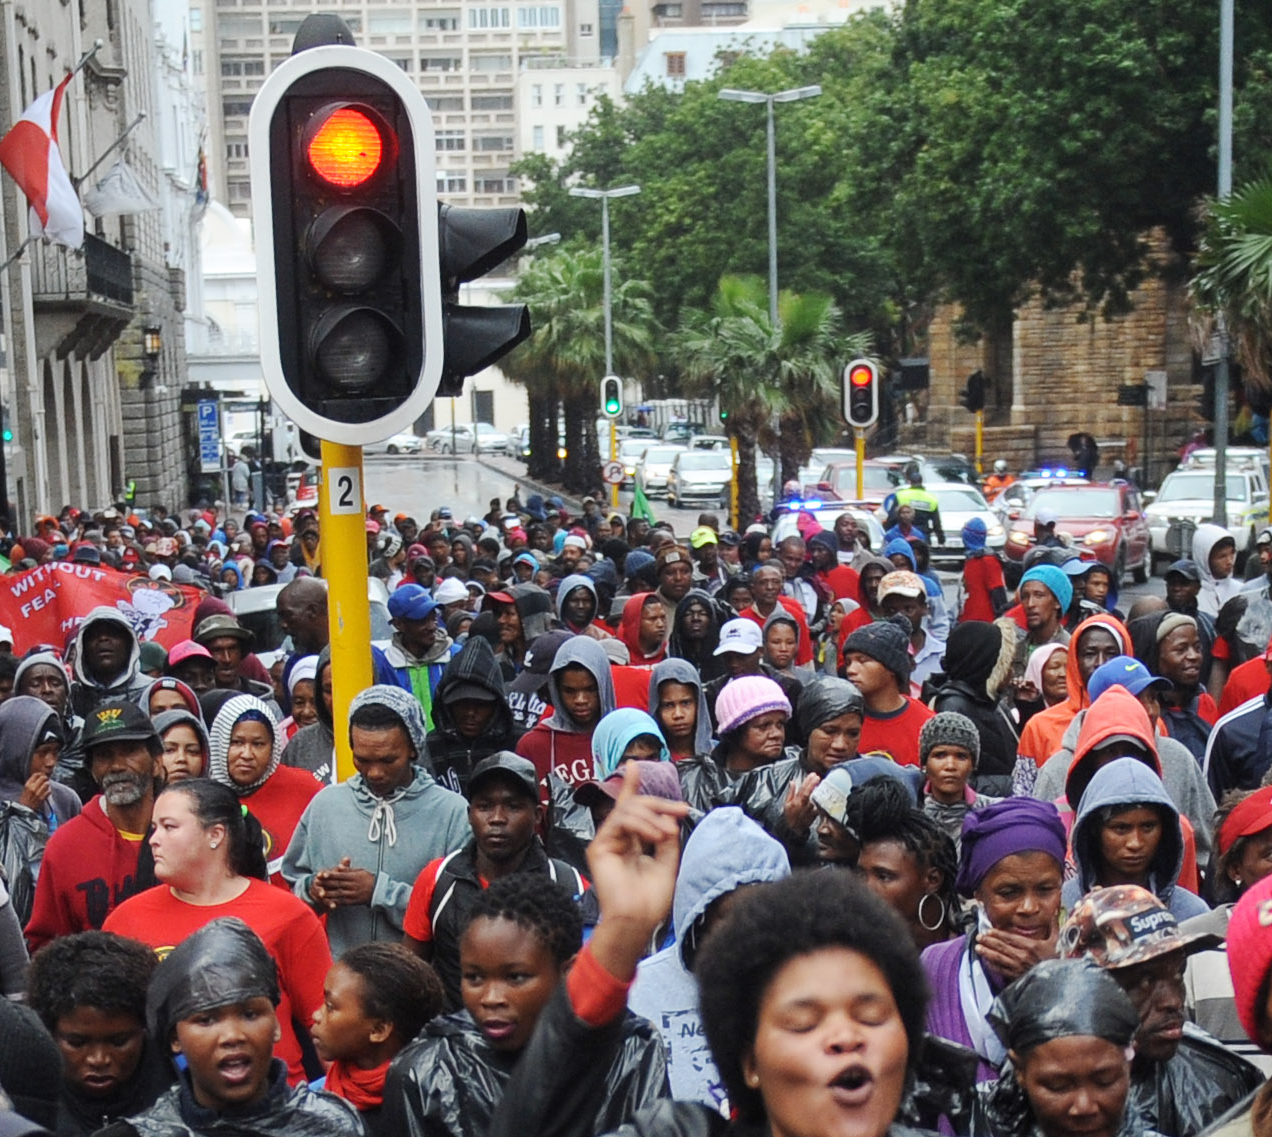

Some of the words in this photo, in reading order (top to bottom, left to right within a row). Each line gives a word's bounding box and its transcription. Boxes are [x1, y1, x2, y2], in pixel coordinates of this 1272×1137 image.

[338, 475, 353, 506] 2
[10, 562, 106, 597] WITHOUT
[20, 580, 61, 618] FEA
